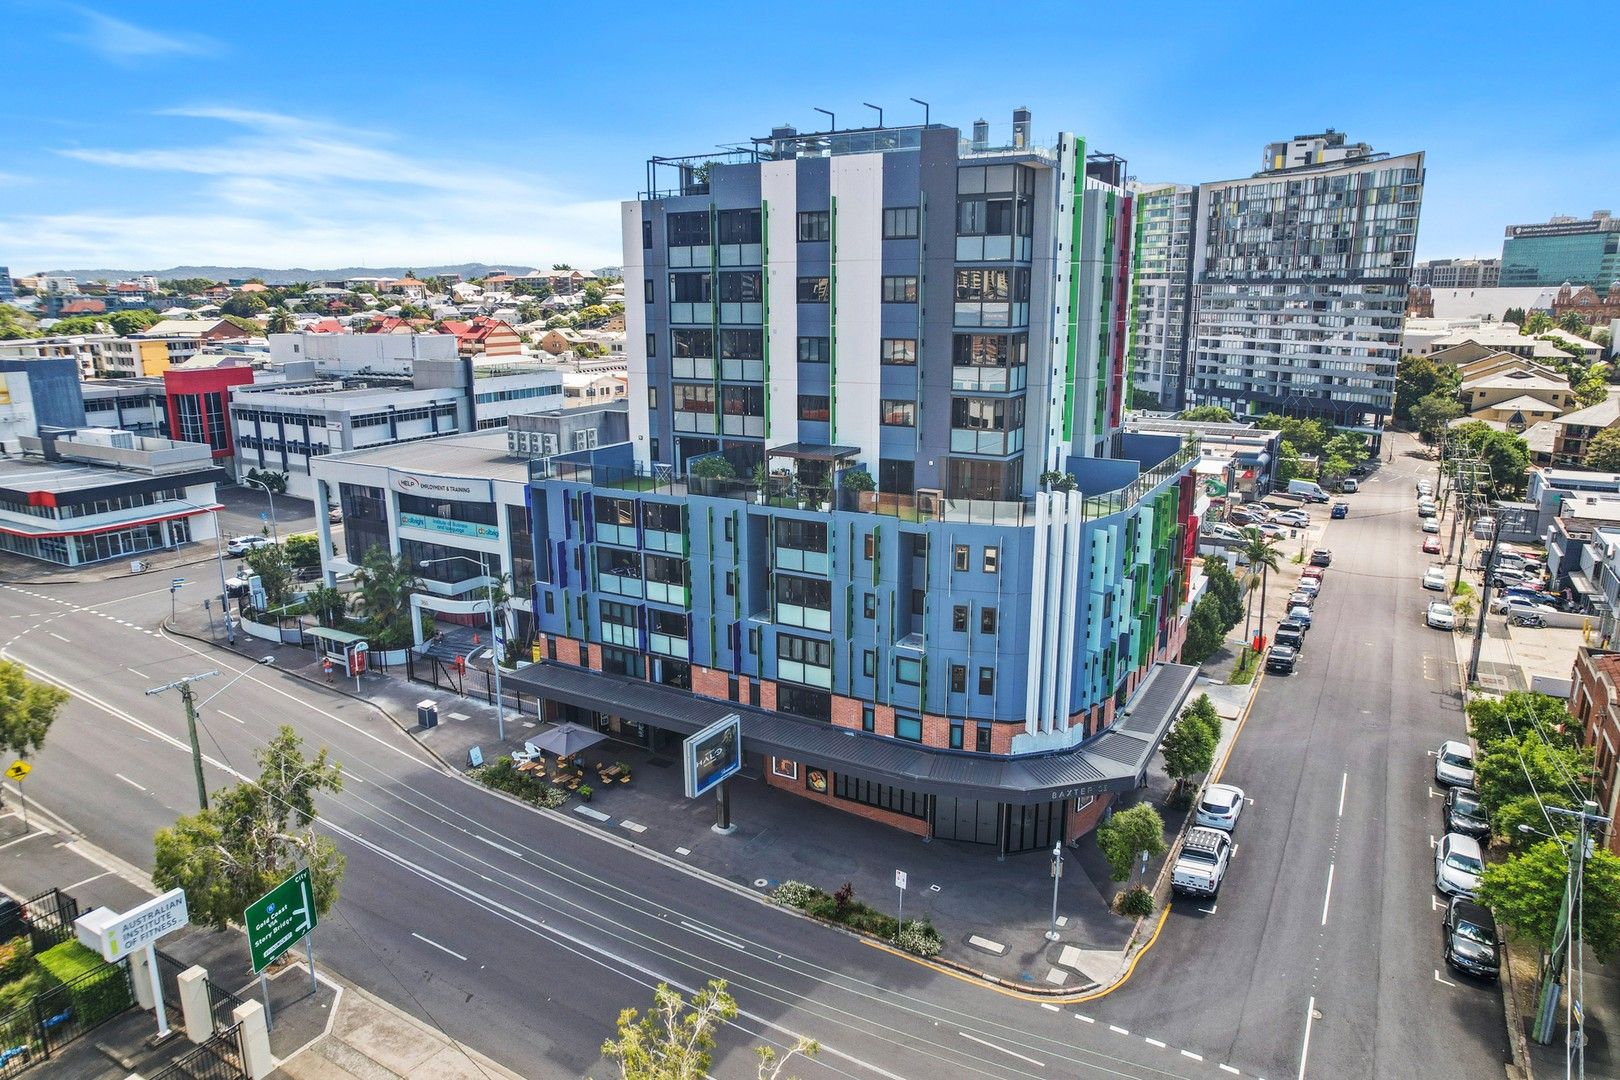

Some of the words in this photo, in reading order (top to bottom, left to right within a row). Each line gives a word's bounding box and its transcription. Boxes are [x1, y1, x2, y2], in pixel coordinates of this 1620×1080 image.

[420, 483, 445, 491] EMPLOYMENT
[696, 748, 723, 767] HALO
[295, 872, 307, 883] City
[122, 898, 183, 932] AUSTRALIAN
[122, 911, 172, 941] INSTITUTE
[255, 917, 270, 931] Gold
[270, 904, 288, 919] Coast
[125, 938, 137, 949] OF
[140, 917, 177, 941] FITNESS
[254, 931, 273, 948] Story
[273, 916, 293, 934] Bridge
